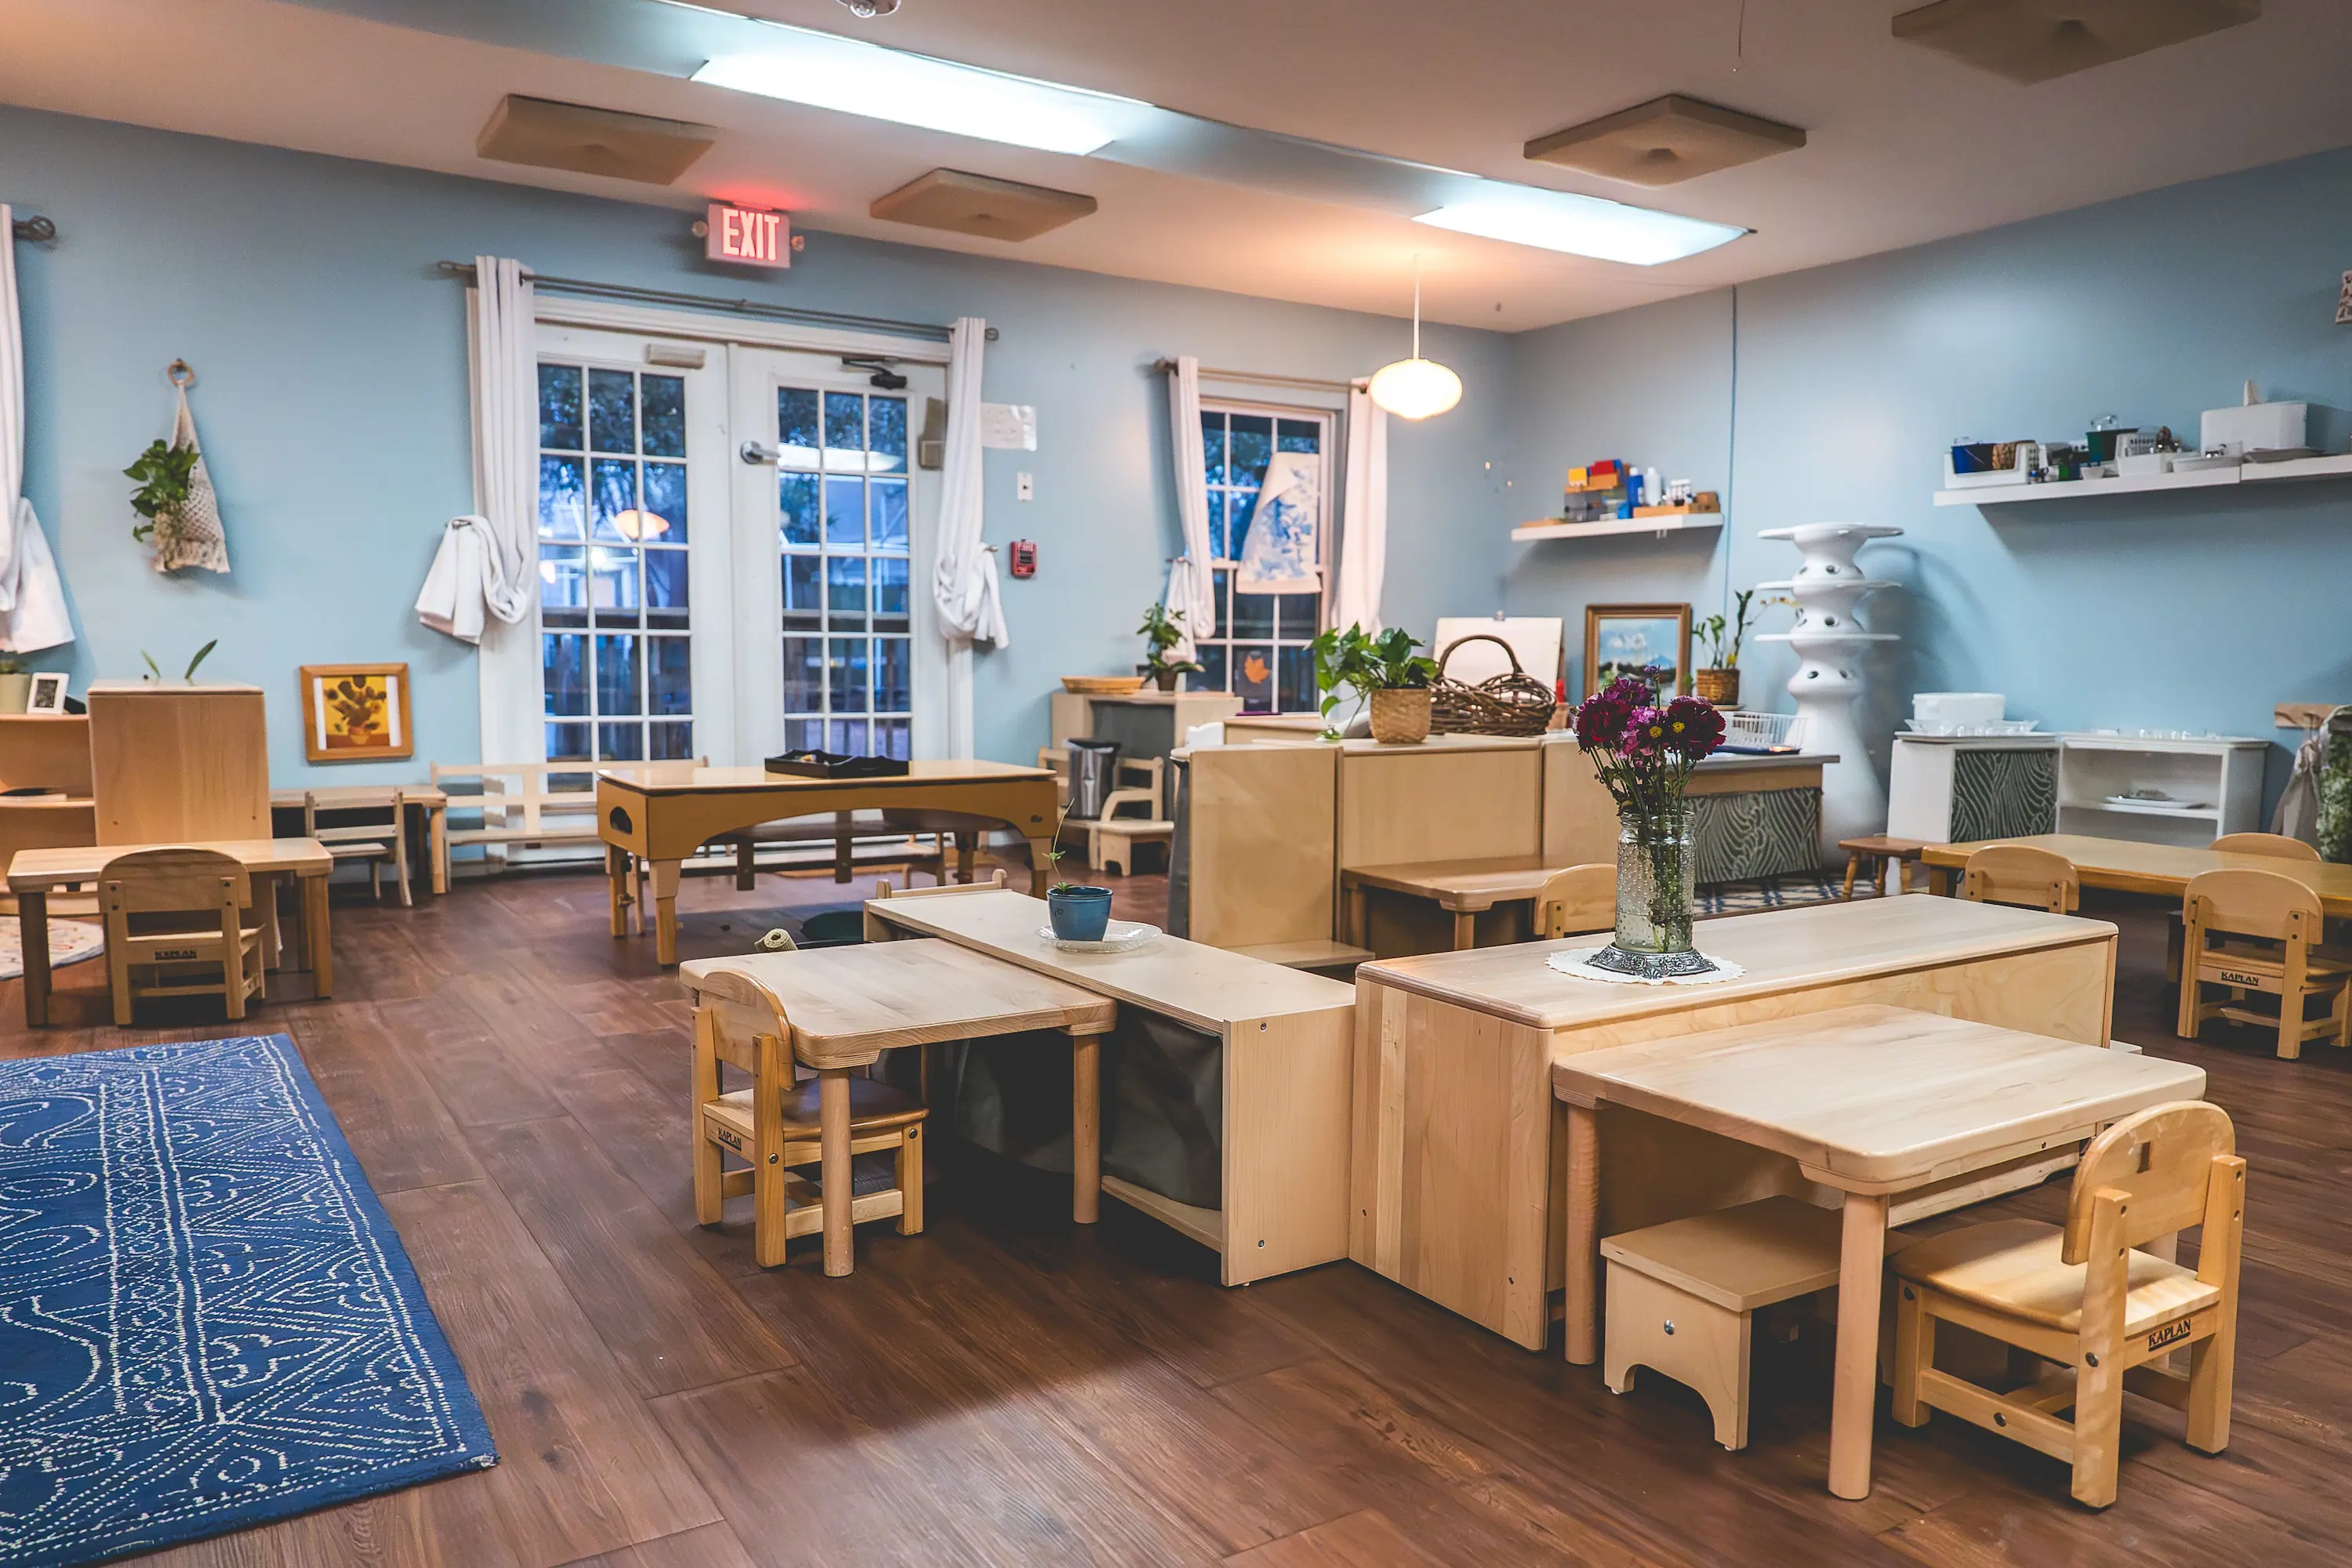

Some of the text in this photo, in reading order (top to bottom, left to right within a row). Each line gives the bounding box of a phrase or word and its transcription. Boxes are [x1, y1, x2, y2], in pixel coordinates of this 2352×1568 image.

[722, 208, 780, 261] EXIT
[2221, 971, 2259, 983] KAPLAN
[718, 1127, 742, 1147] KAPLAN
[2148, 1319, 2191, 1346] KAPLAN
